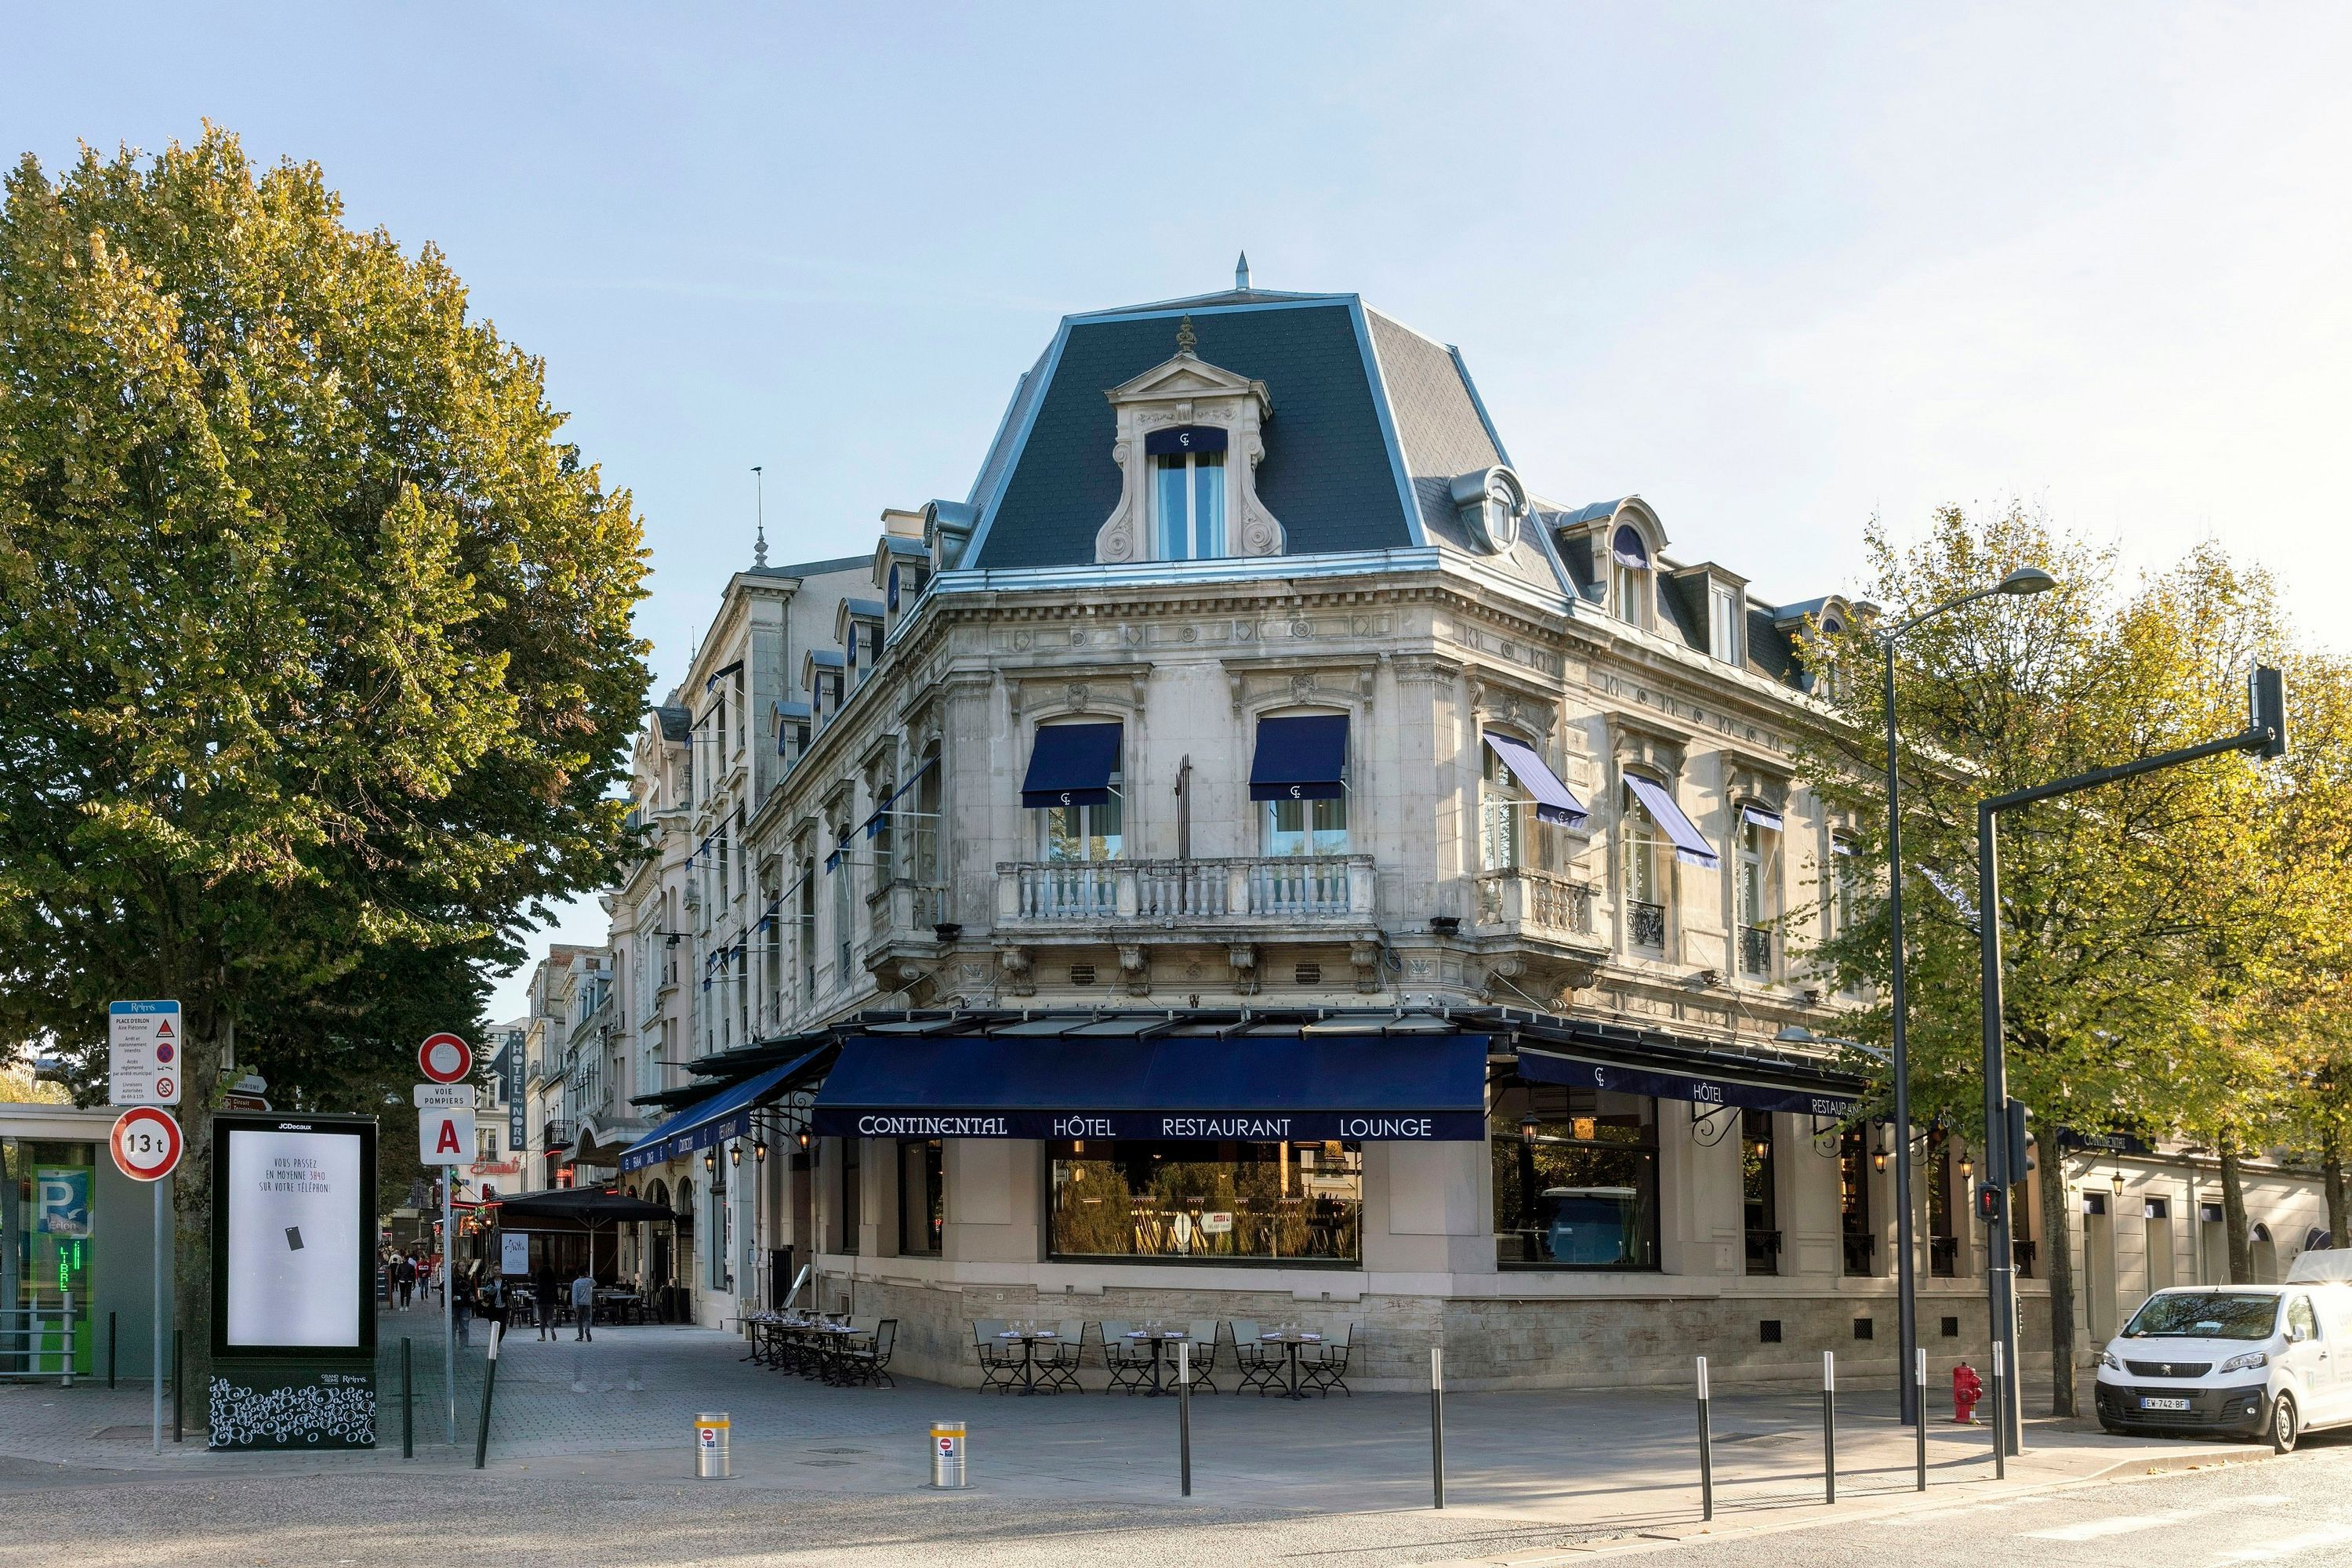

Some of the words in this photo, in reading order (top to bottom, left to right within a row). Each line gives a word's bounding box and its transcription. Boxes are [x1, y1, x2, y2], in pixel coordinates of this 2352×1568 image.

[131, 1002, 156, 1012] Reims
[512, 1044, 524, 1094] HOTEL
[235, 1082, 260, 1091] TOURISME
[1693, 1082, 1724, 1103] HÔTEL
[512, 1108, 524, 1145] NORD
[858, 1115, 1008, 1135] CONTINENTAL
[1054, 1115, 1116, 1136] HÔTEL
[1163, 1118, 1291, 1136] RESTAURANT
[1340, 1118, 1432, 1137] LOUNGE
[127, 1134, 151, 1153] 13
[156, 1138, 164, 1153] t
[436, 1120, 460, 1153] A
[274, 1158, 290, 1167] VOUS
[294, 1158, 317, 1169] PASSEZ
[266, 1170, 274, 1179] EN
[278, 1170, 306, 1180] MOYENNE
[310, 1171, 325, 1181] 3H40
[259, 1181, 271, 1192] SUR
[275, 1182, 294, 1192] VOTRE
[39, 1181, 74, 1219] P
[49, 1220, 76, 1229] Erlon
[60, 1246, 69, 1291] LIBRE
[343, 1375, 367, 1384] Reims
[2147, 1399, 2185, 1409] EW-742-BF
